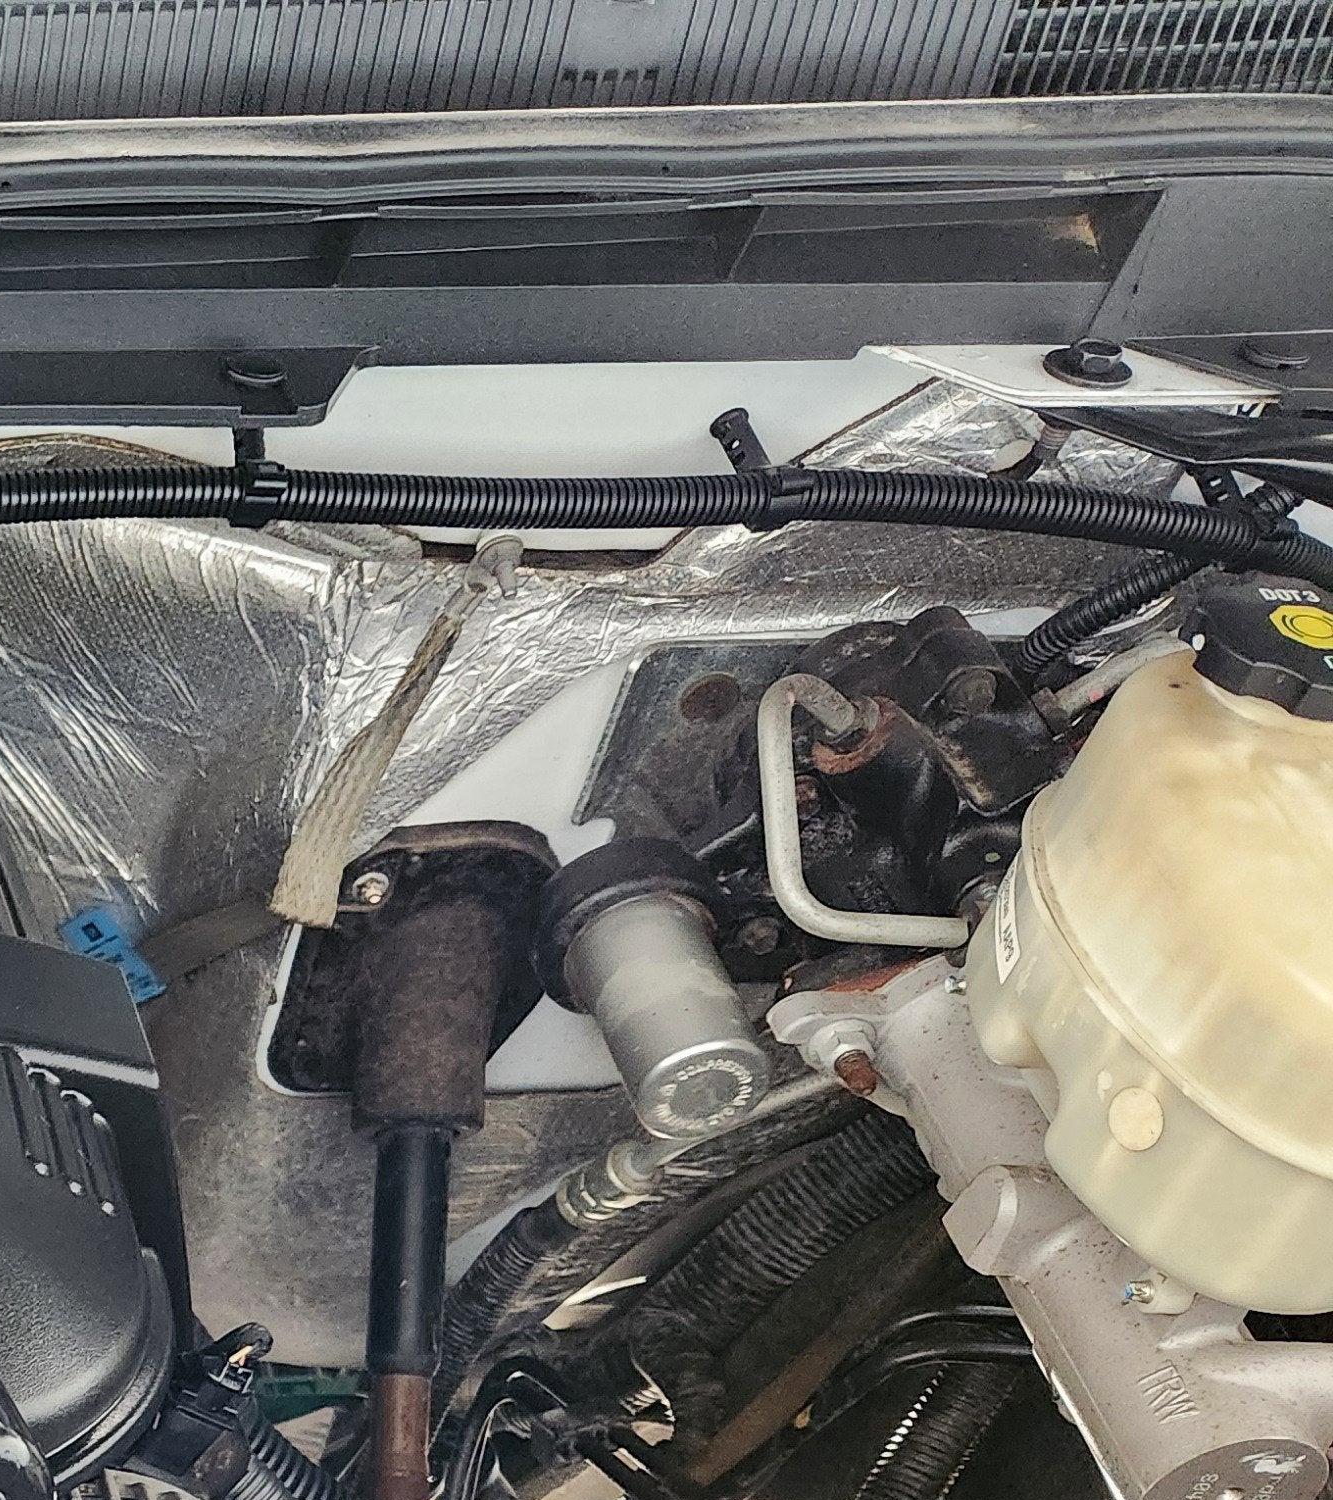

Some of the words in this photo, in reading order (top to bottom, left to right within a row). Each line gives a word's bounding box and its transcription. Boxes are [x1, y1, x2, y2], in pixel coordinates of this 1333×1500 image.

[1258, 586, 1302, 603] DOT
[1302, 589, 1321, 603] 3
[1136, 1358, 1201, 1425] TRW
